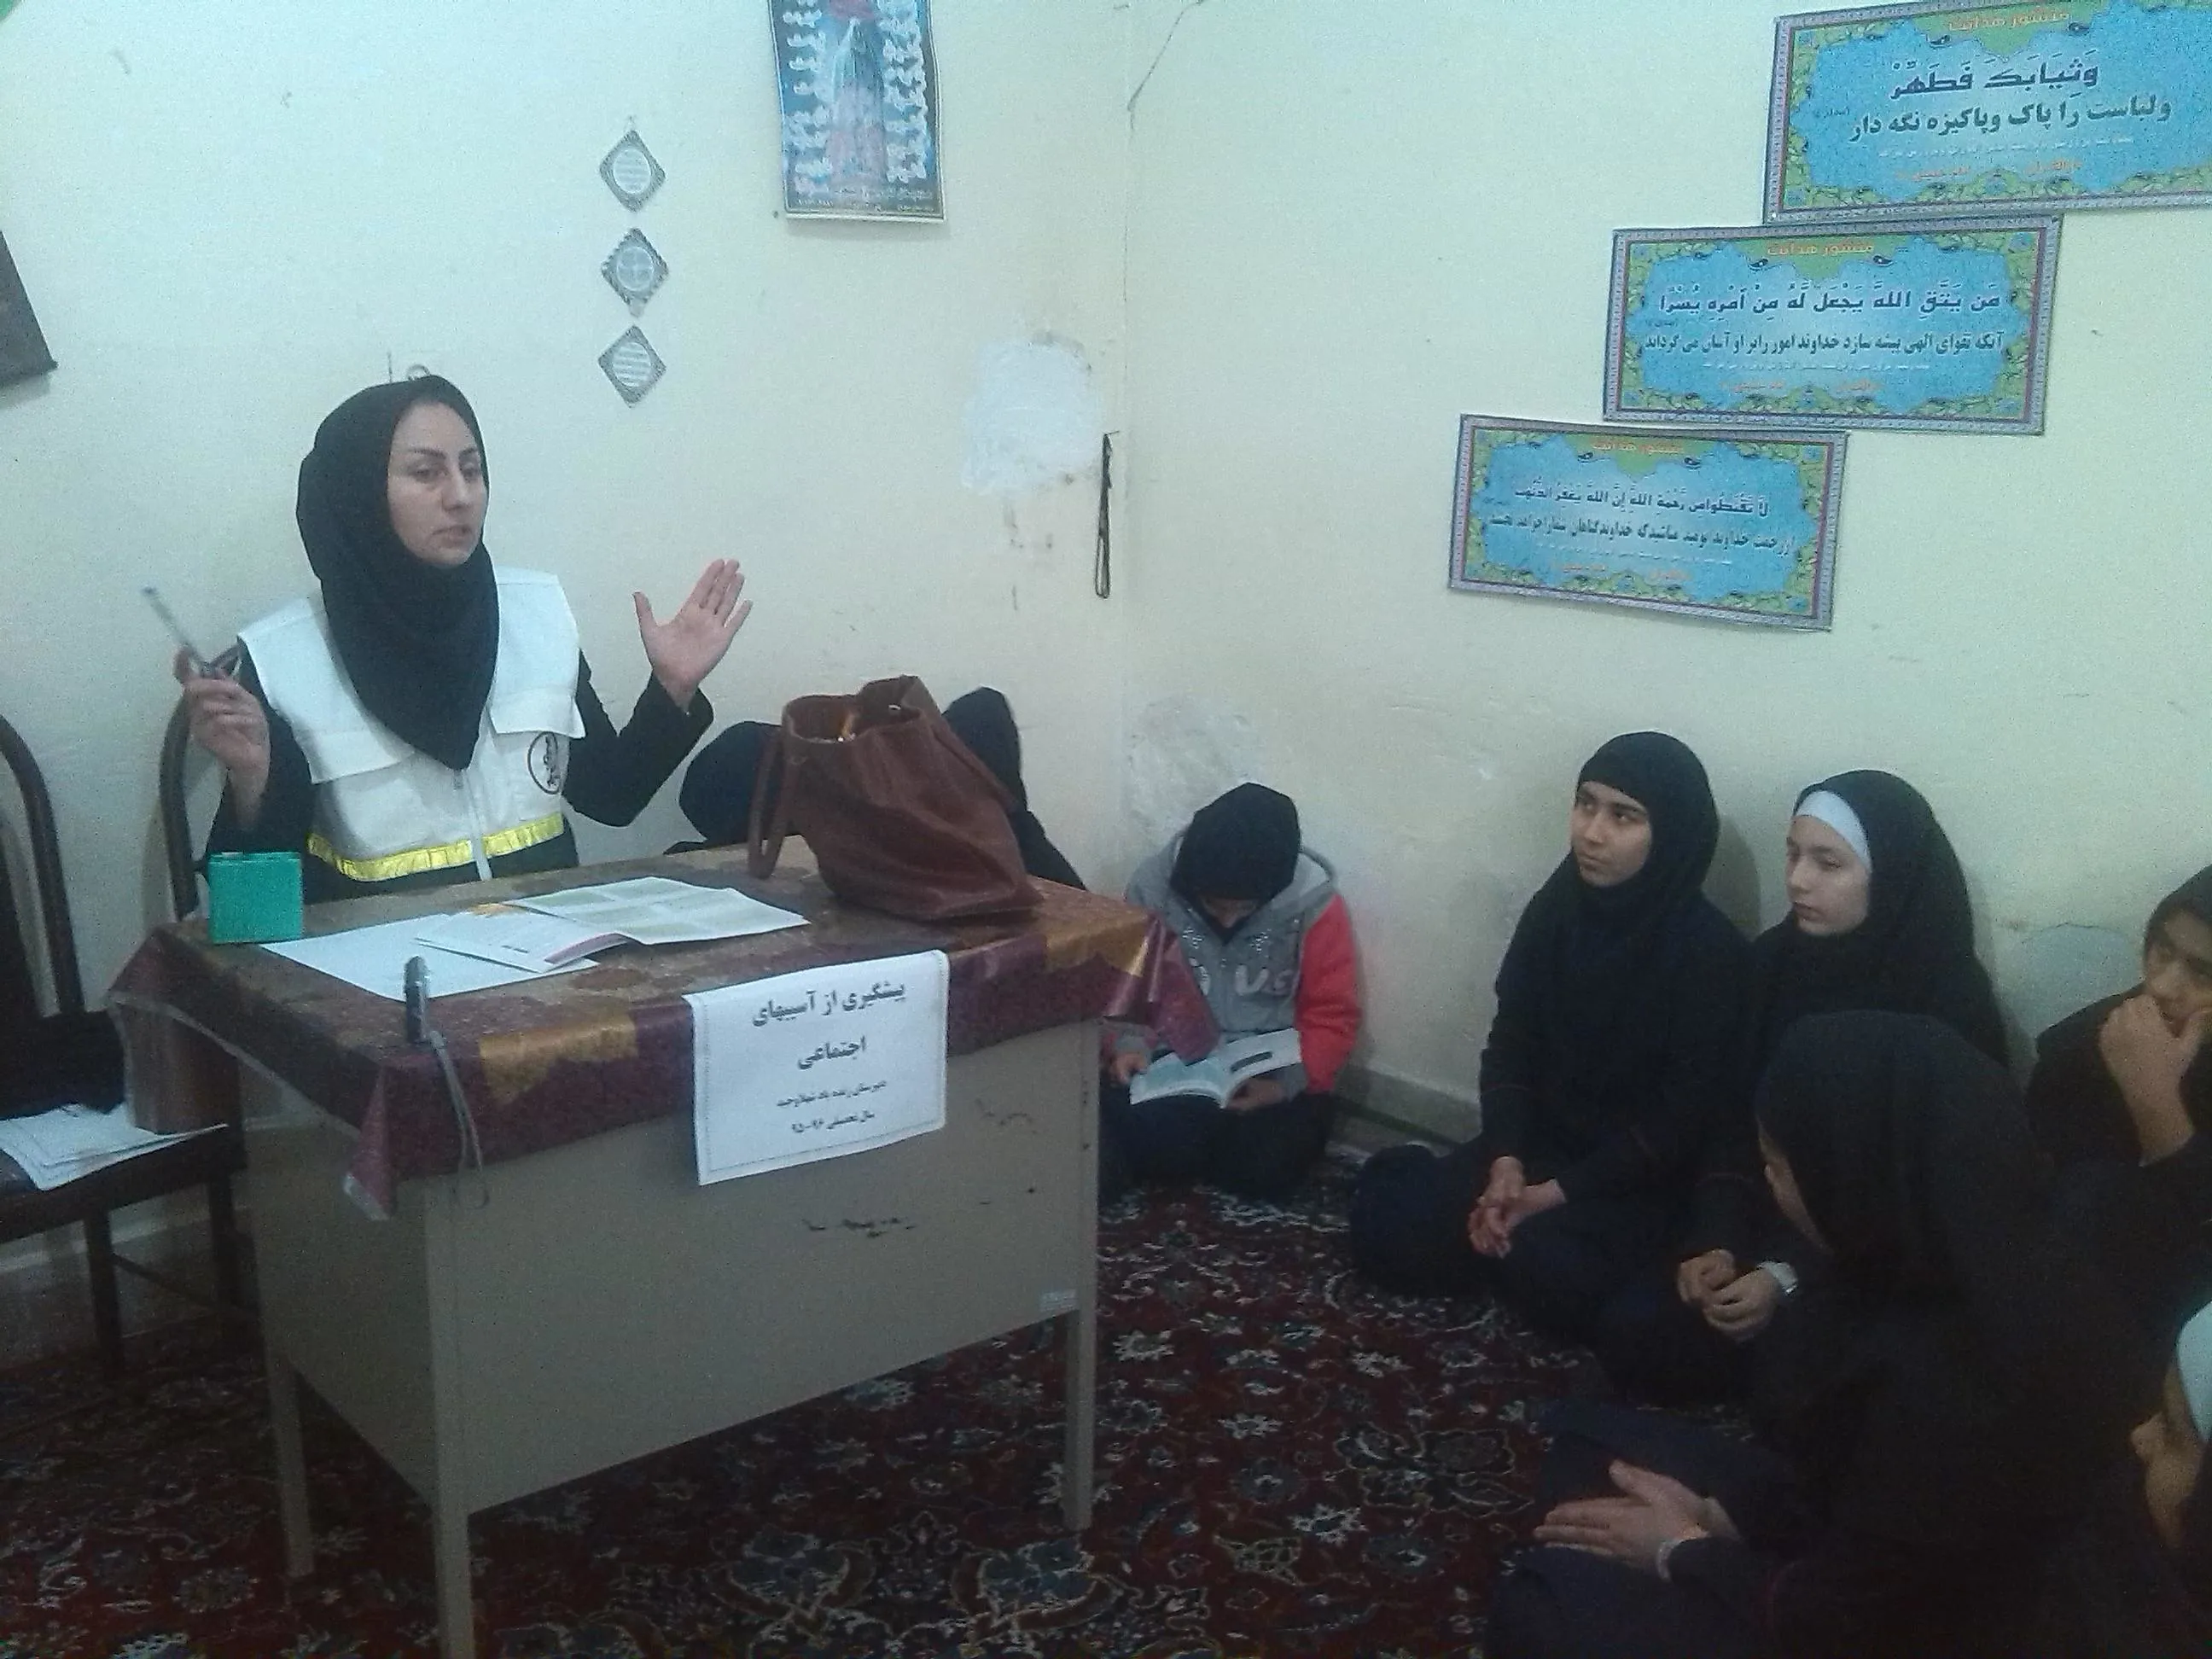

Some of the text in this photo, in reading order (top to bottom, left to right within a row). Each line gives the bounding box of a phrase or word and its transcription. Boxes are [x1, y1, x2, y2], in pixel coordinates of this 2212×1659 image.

[2007, 103, 2052, 131] پاک
[2058, 101, 2080, 127] را
[1848, 115, 1883, 142] دار
[821, 989, 838, 1016] از
[798, 1035, 867, 1070] اجتماعی
